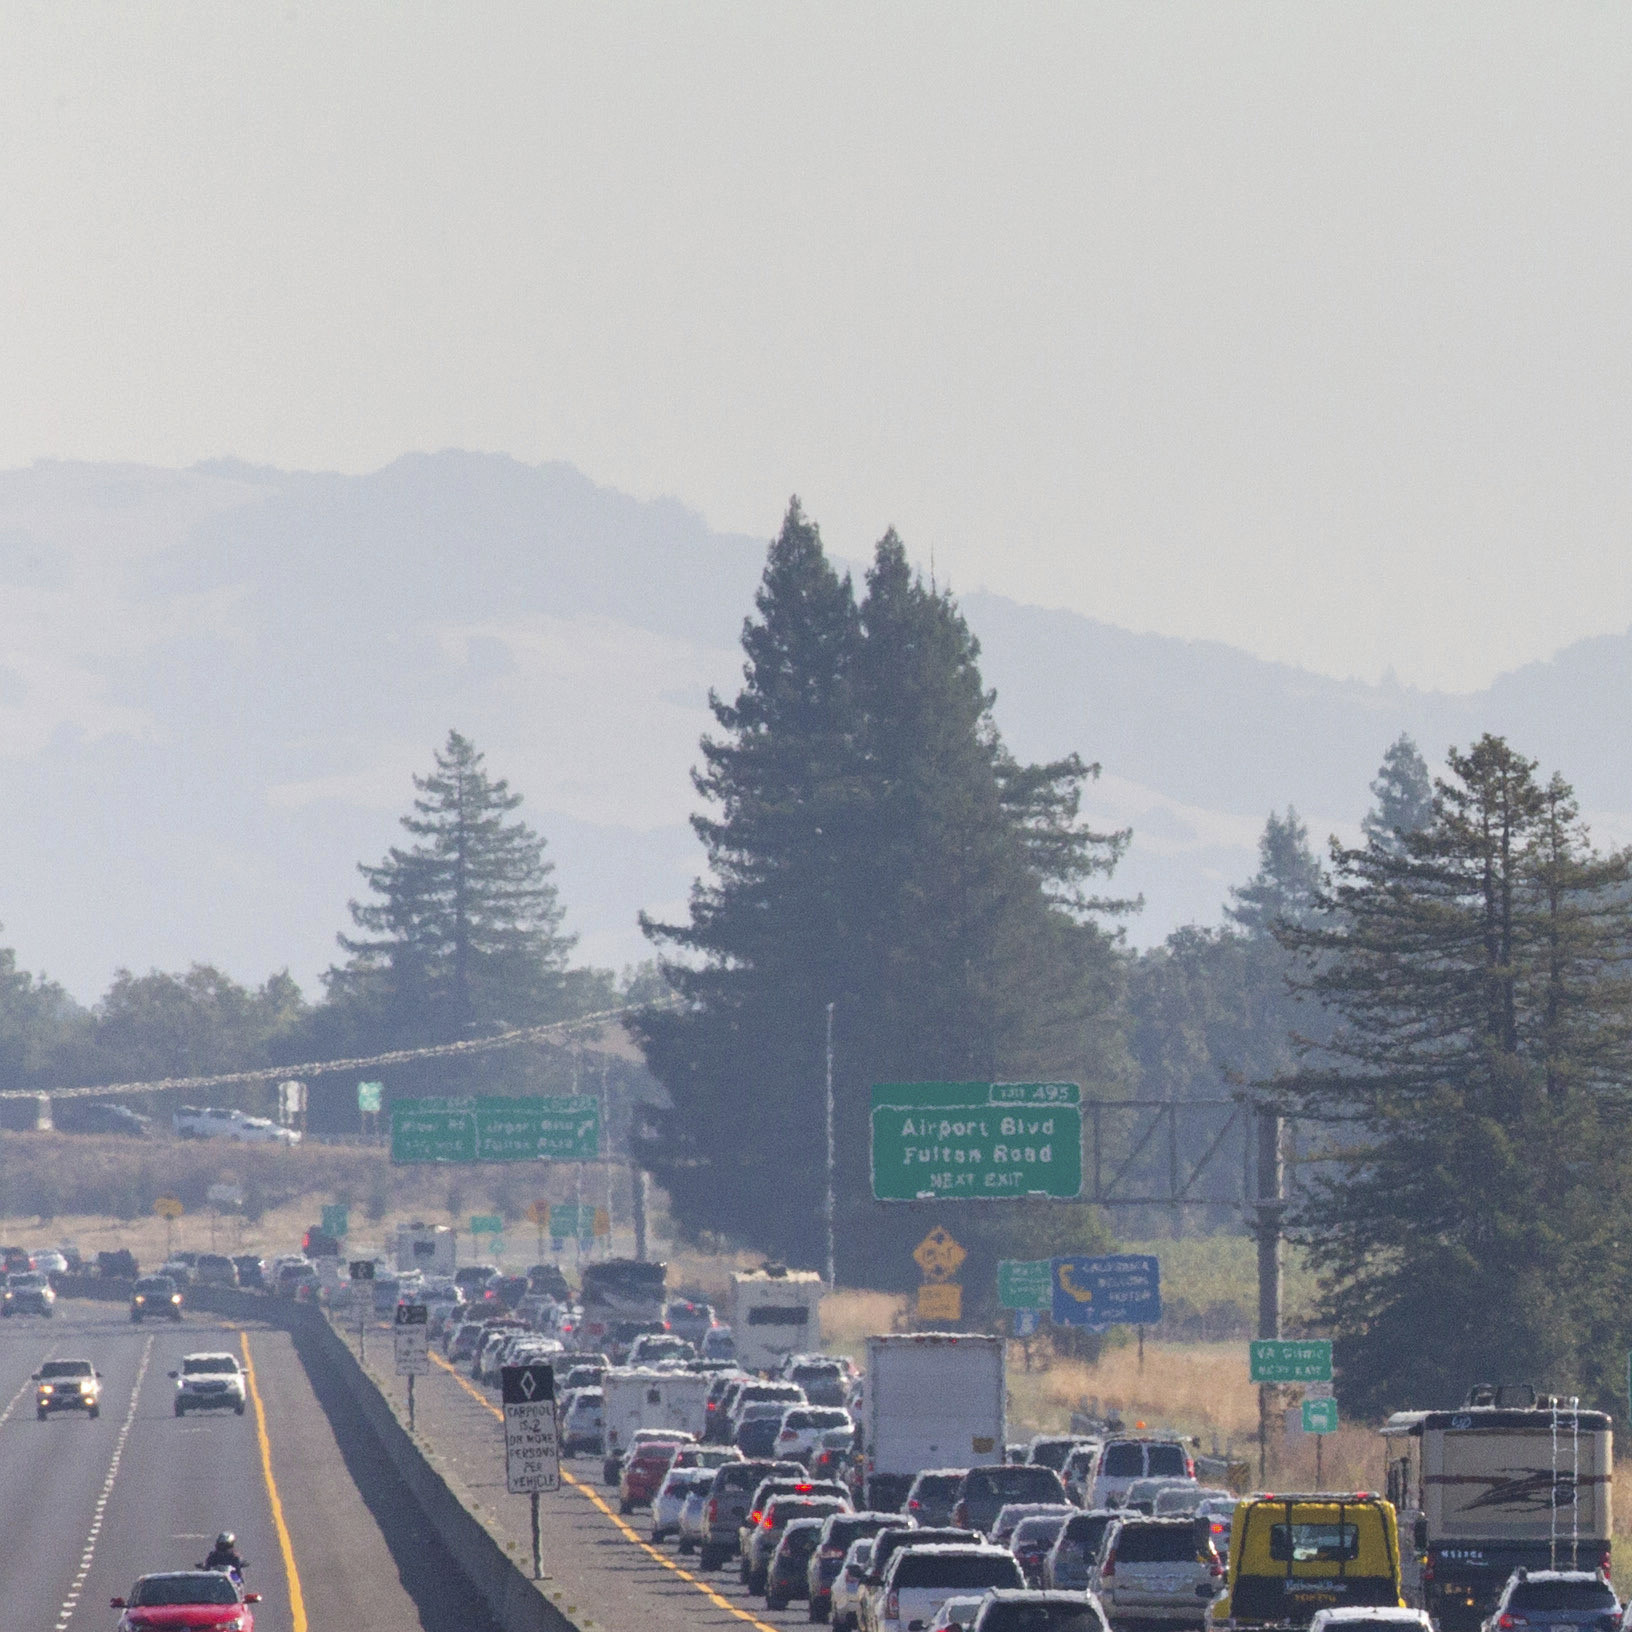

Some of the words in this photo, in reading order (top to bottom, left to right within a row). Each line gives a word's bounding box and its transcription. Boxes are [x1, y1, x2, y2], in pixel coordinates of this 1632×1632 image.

[901, 1118, 989, 1141] Airport
[1000, 1117, 1054, 1136] Blvd
[903, 1145, 982, 1165] Fulton
[993, 1144, 1053, 1163] Road
[930, 1172, 975, 1189] NEXT
[984, 1172, 1024, 1188] EXIT
[508, 1407, 555, 1417] CARPOOL
[513, 1475, 555, 1487] VEHICLE
